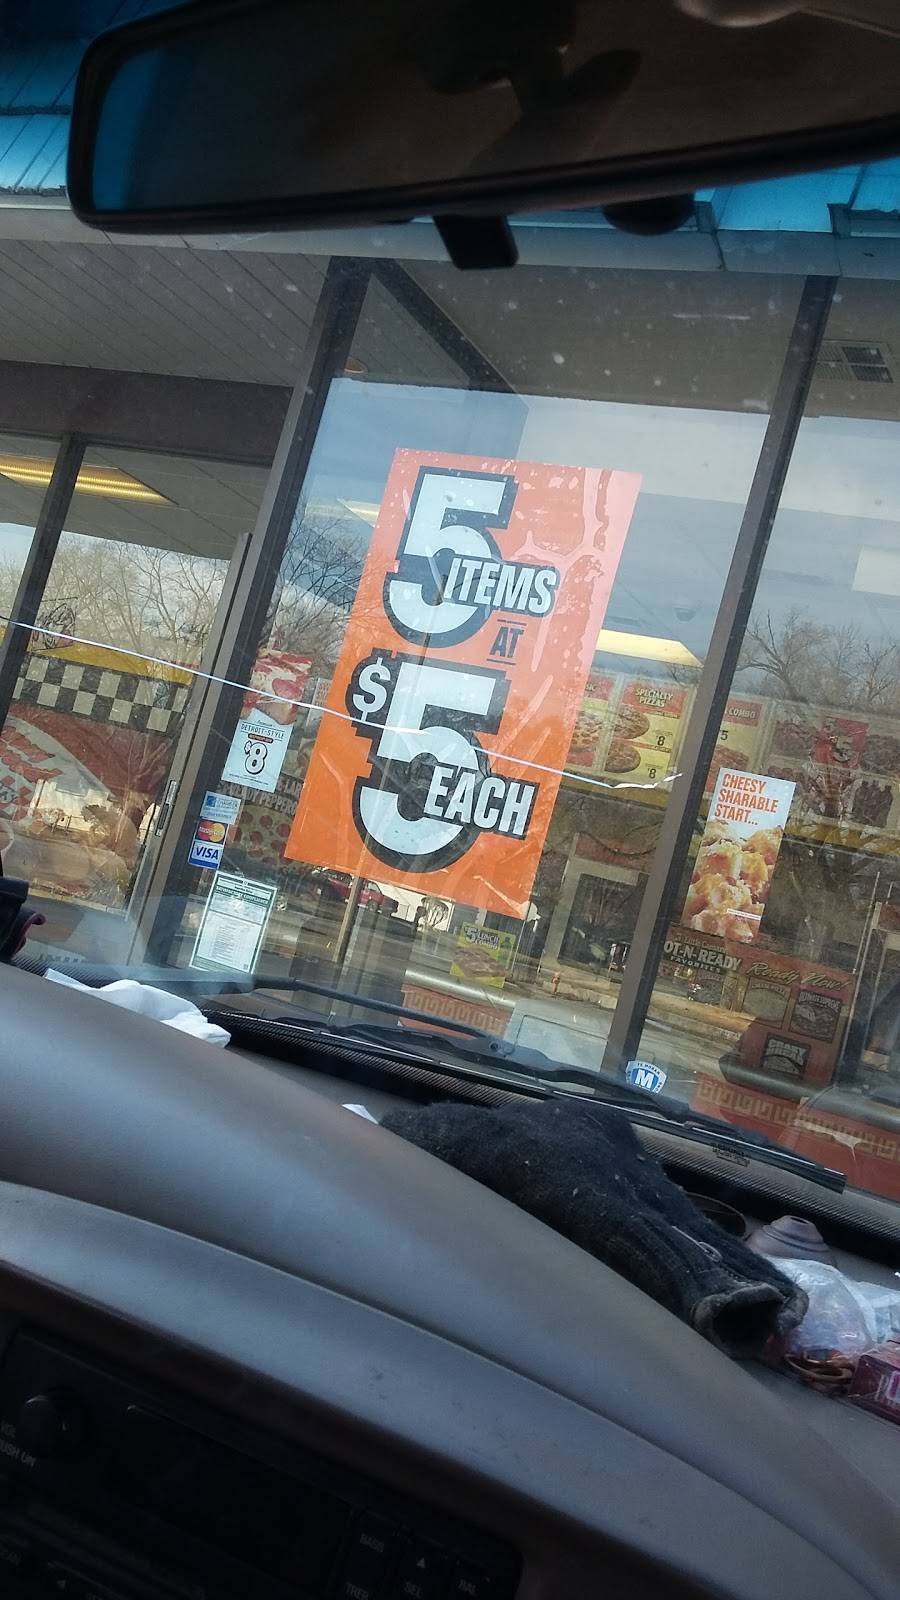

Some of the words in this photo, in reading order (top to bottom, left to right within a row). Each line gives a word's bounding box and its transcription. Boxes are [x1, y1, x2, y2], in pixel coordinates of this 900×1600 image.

[388, 472, 508, 635] 5
[442, 557, 557, 618] ITEMS
[489, 626, 524, 659] AT
[639, 696, 666, 708] PIZZAS
[244, 740, 268, 775] $8
[721, 773, 768, 794] CHEESY
[423, 764, 536, 837] EACH
[713, 803, 759, 826] START...
[718, 787, 779, 814] SHARABLE
[195, 845, 220, 860] VISA
[663, 940, 742, 971] OT-N-READY
[634, 1068, 655, 1090] M
